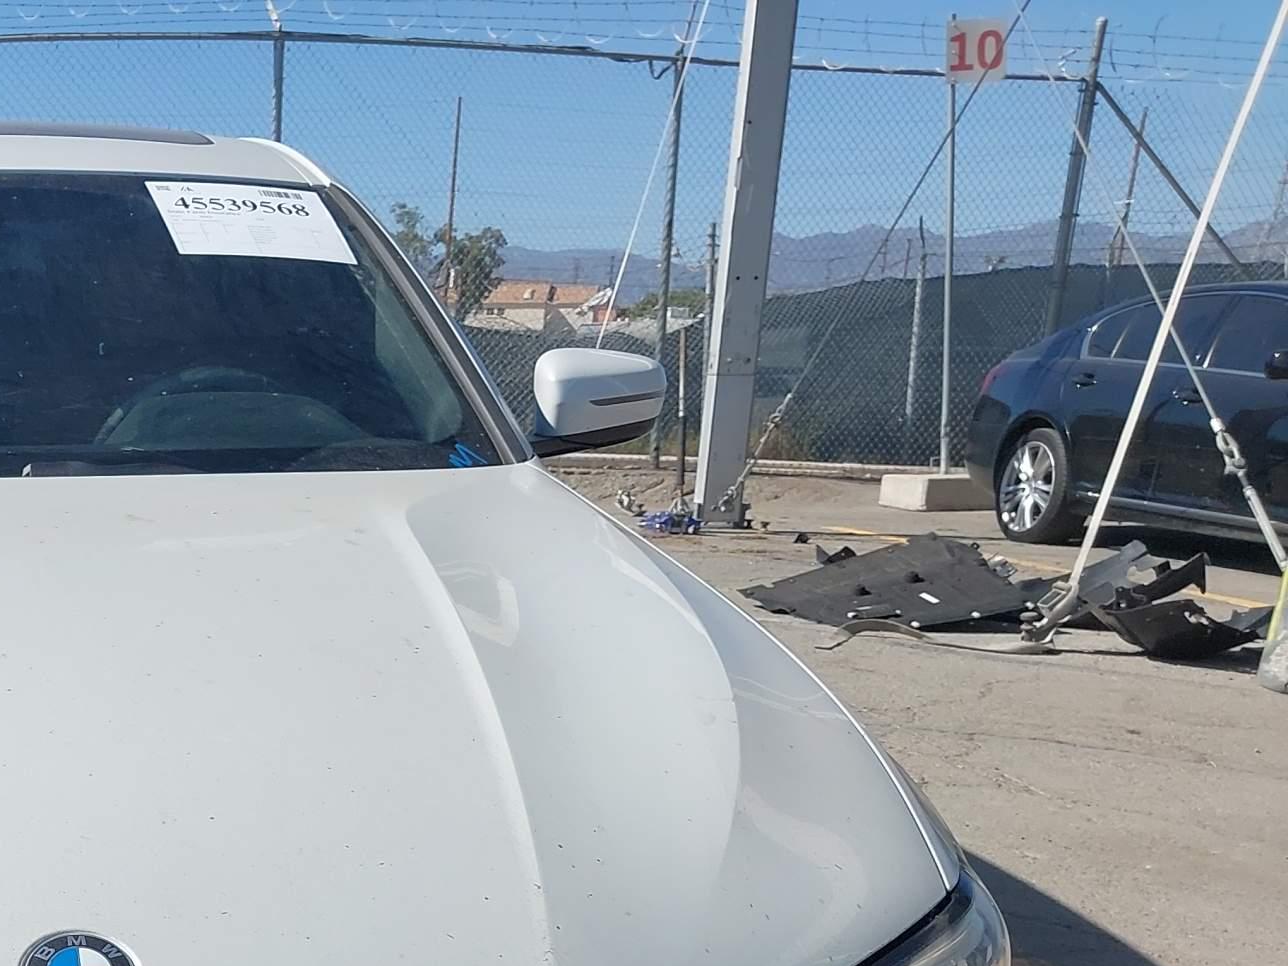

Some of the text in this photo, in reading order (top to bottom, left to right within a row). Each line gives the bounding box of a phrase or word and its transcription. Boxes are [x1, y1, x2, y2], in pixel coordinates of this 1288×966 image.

[949, 29, 1004, 72] 10
[174, 196, 311, 217] 45539568
[34, 935, 123, 961] BMW
